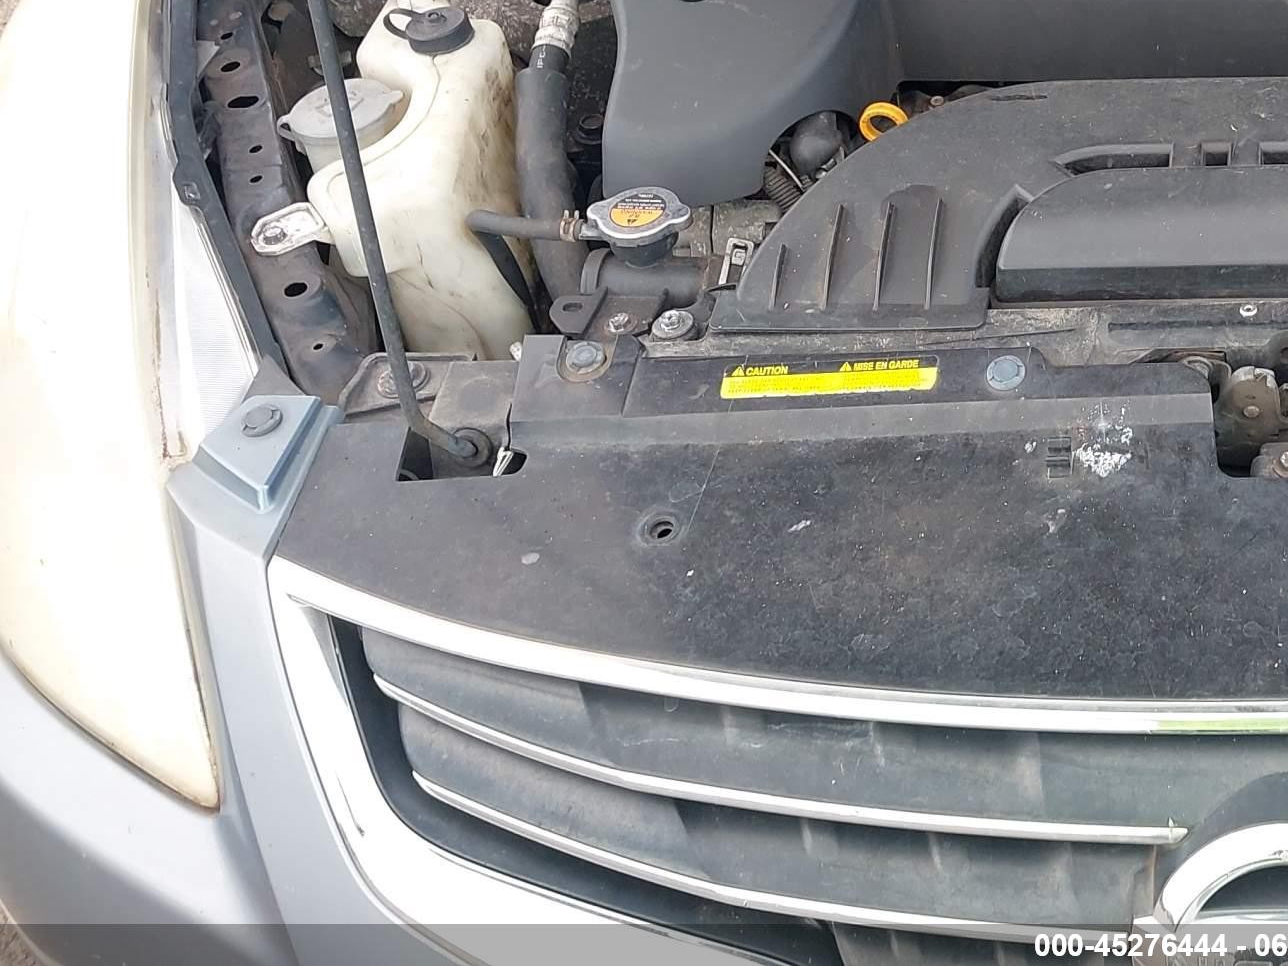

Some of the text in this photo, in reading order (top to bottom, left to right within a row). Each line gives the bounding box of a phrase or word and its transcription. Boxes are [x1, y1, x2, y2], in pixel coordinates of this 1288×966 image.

[853, 359, 920, 371] MISE EN GARDE
[746, 366, 789, 376] CAUTION
